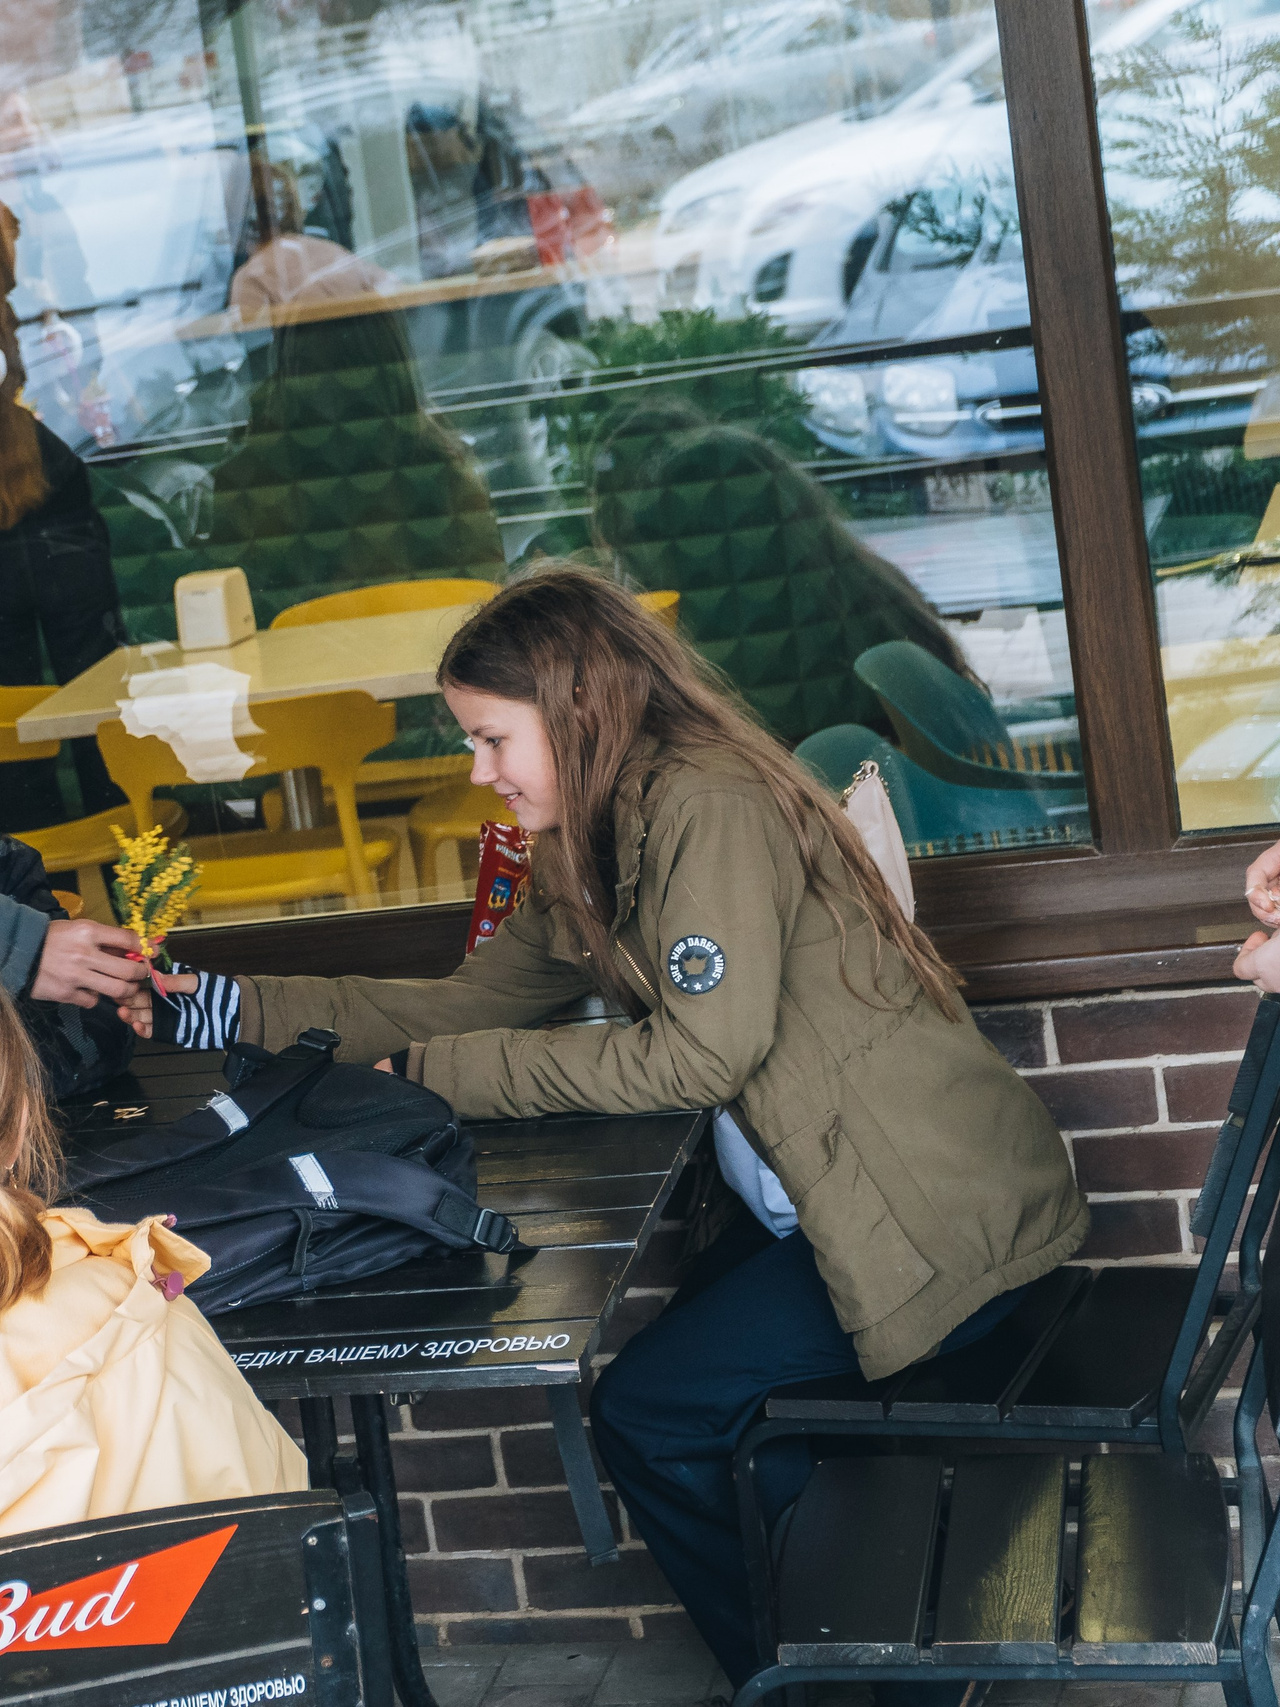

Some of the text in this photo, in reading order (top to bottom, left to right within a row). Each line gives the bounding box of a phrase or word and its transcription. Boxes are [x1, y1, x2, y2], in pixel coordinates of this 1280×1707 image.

[670, 937, 724, 983] SHE WHO DARES WINS
[304, 1342, 419, 1364] ВАШЕМУ
[420, 1333, 571, 1359] ЗДОРОВЬЮ
[230, 1673, 306, 1707] ЗДОРОВЬЮ
